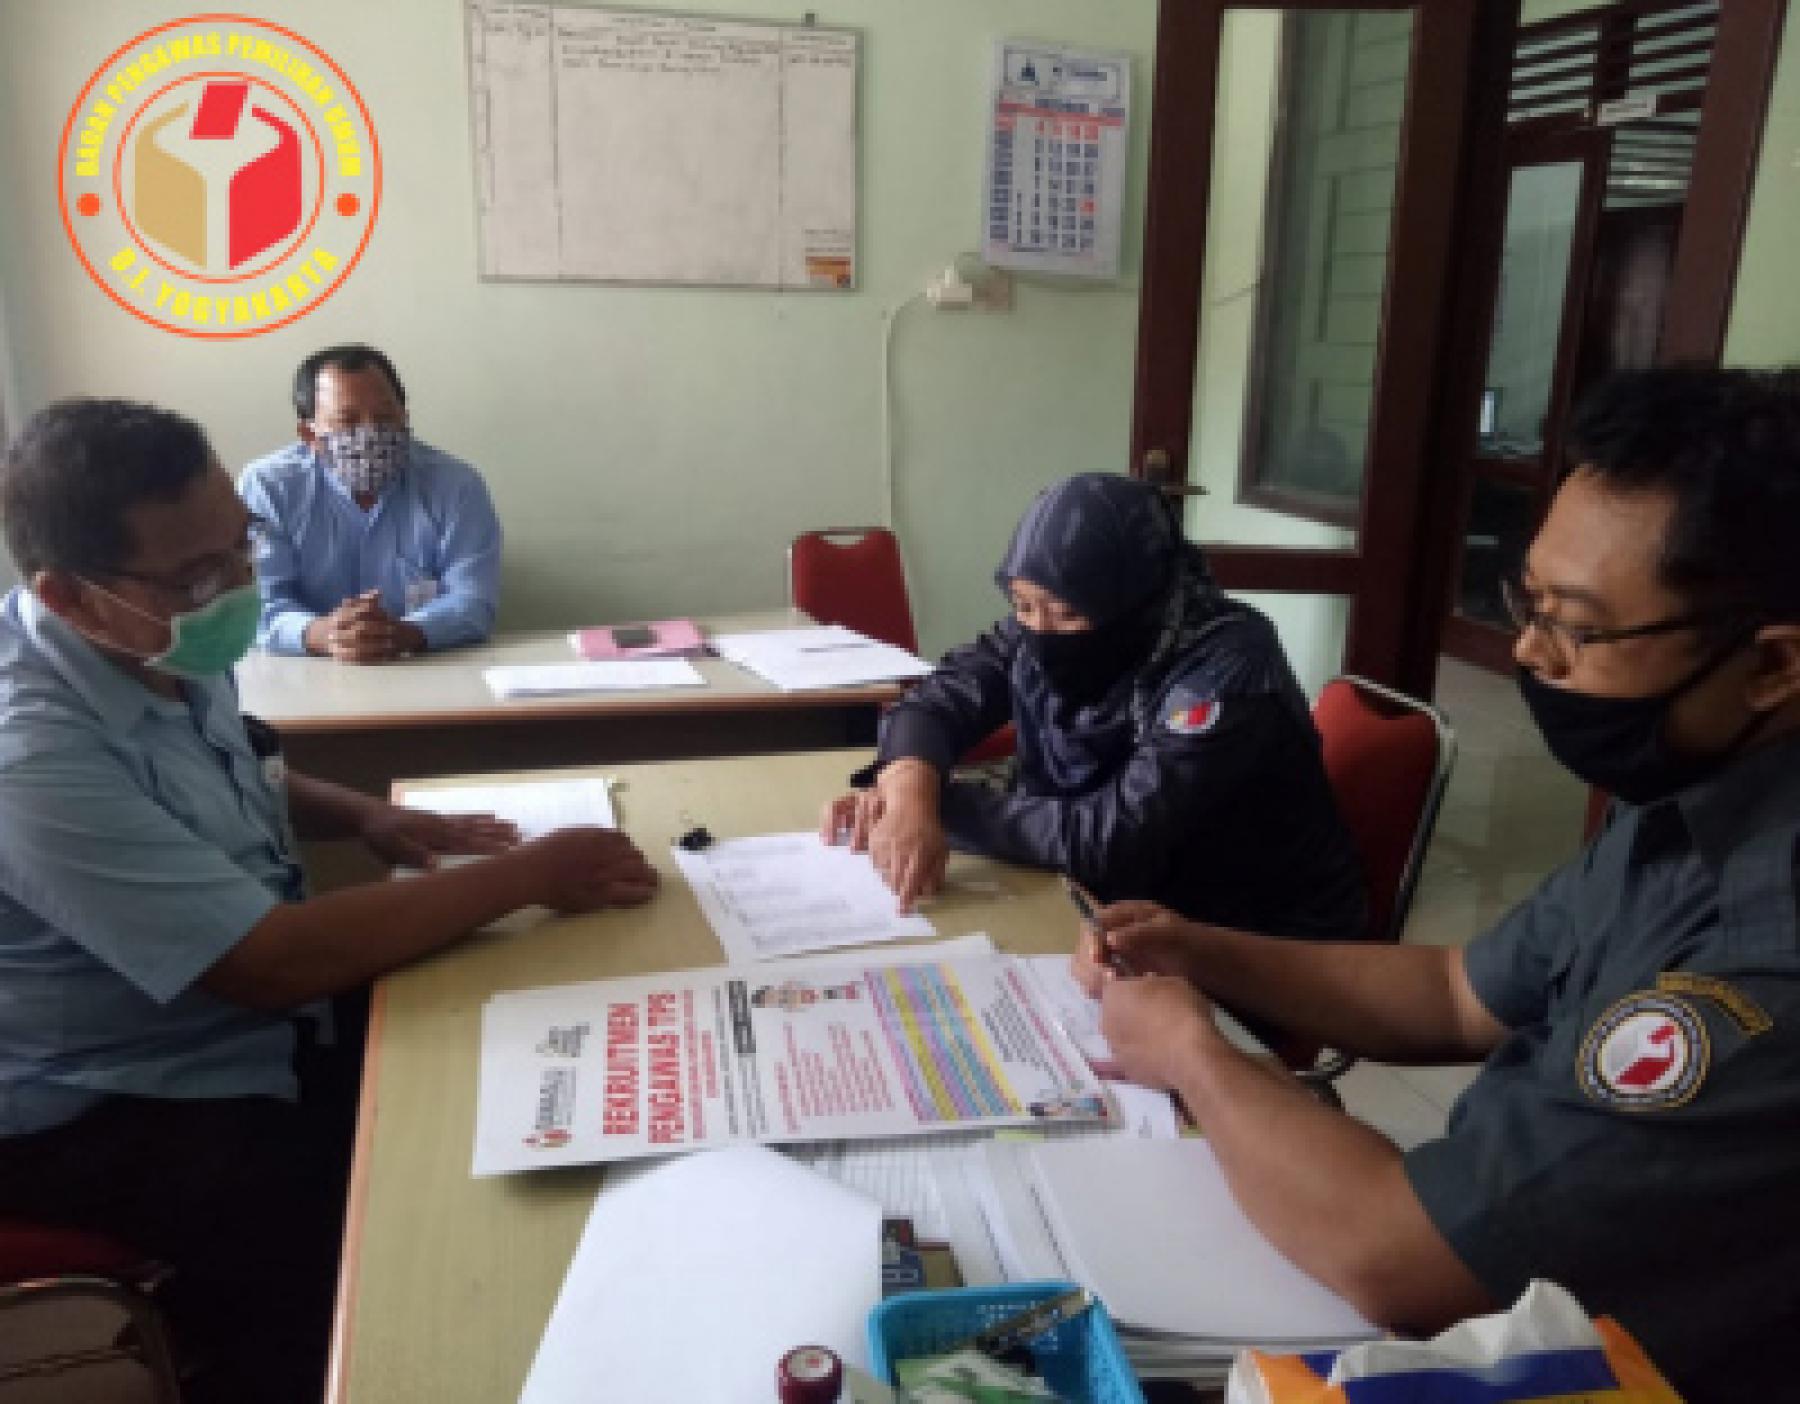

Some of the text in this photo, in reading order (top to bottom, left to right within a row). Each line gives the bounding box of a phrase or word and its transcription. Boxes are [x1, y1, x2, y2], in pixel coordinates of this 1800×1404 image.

[602, 1003, 640, 1134] REKRUITMEN
[647, 993, 685, 1143] PENGAWAS TPS
